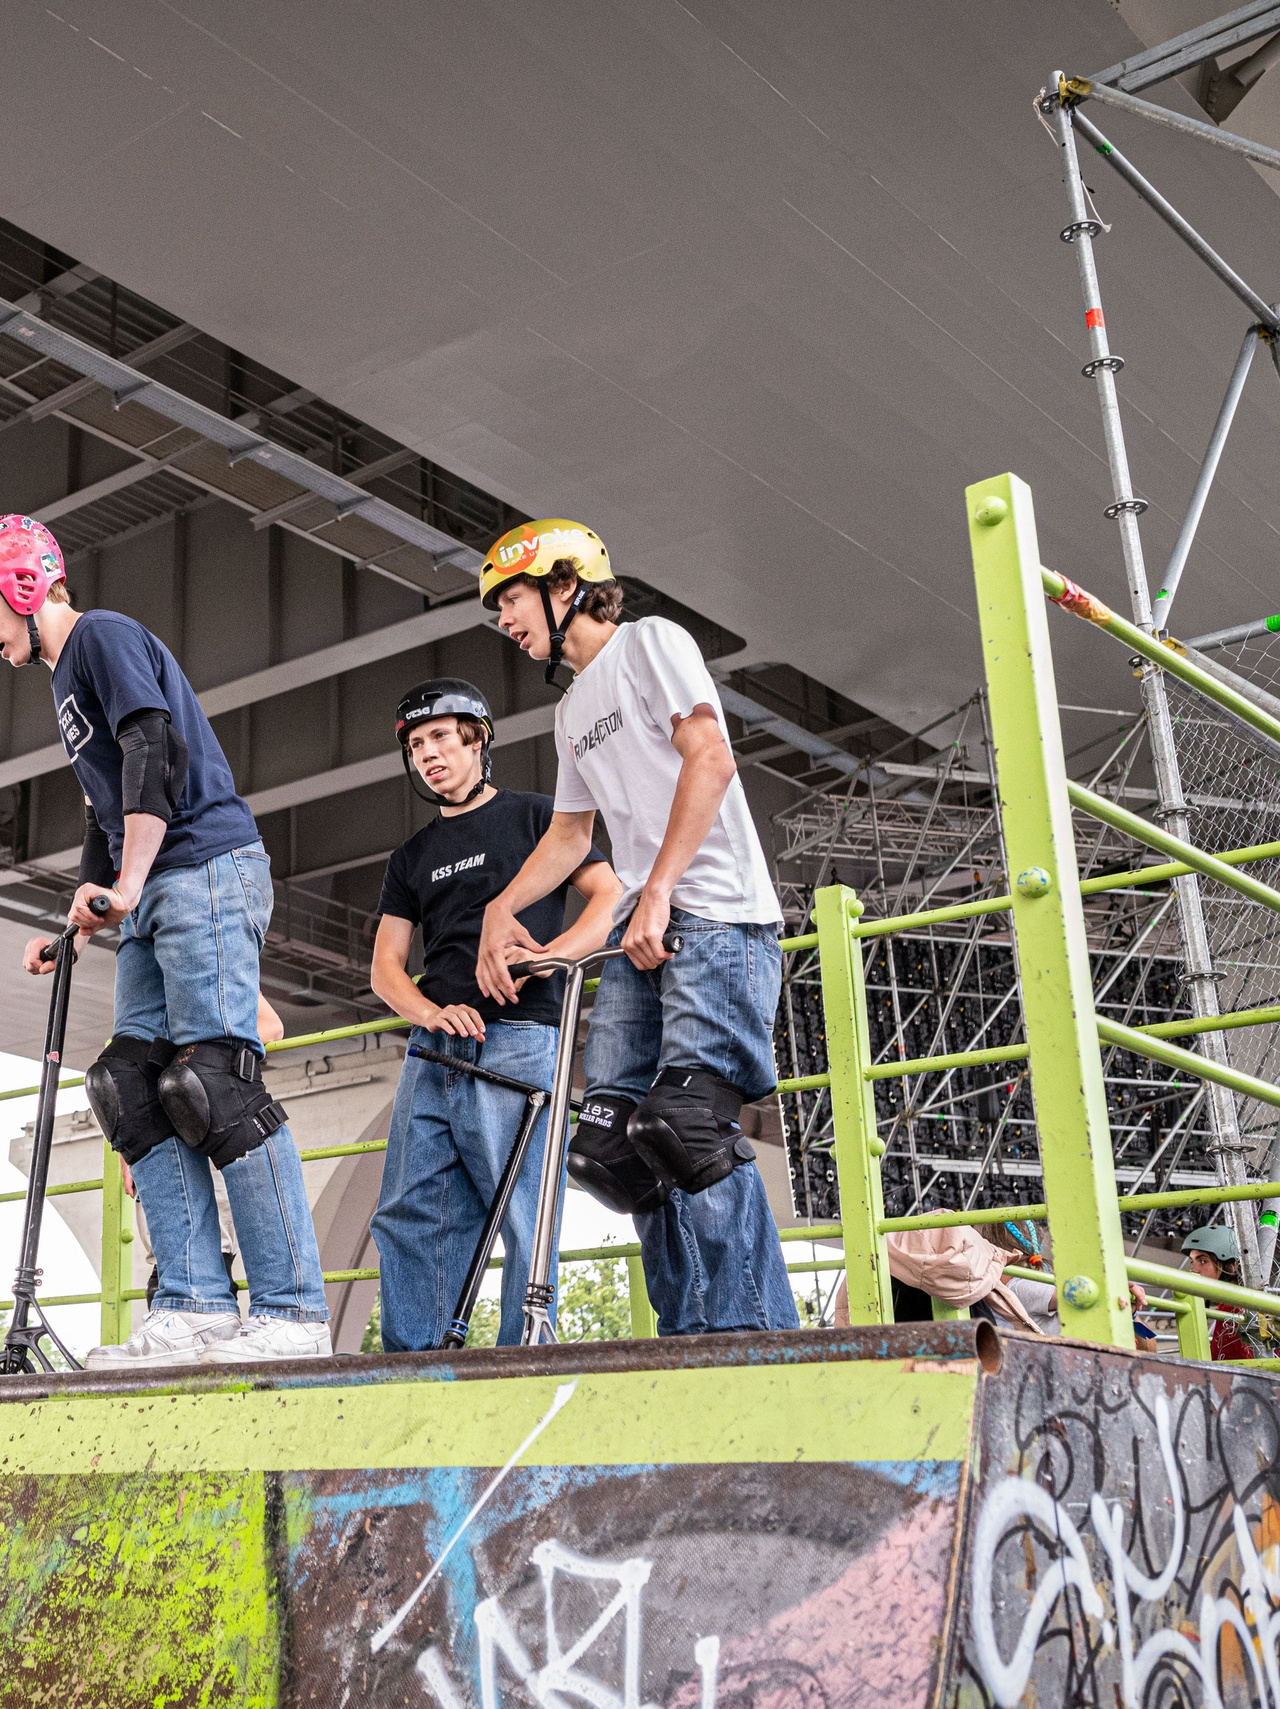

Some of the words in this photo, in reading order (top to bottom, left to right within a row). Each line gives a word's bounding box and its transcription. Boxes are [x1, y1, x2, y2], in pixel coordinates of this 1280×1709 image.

[499, 527, 586, 563] invoke
[432, 865, 452, 882] KSS
[454, 853, 486, 873] TEAM
[583, 1103, 615, 1119] 187
[594, 1116, 613, 1128] PADS
